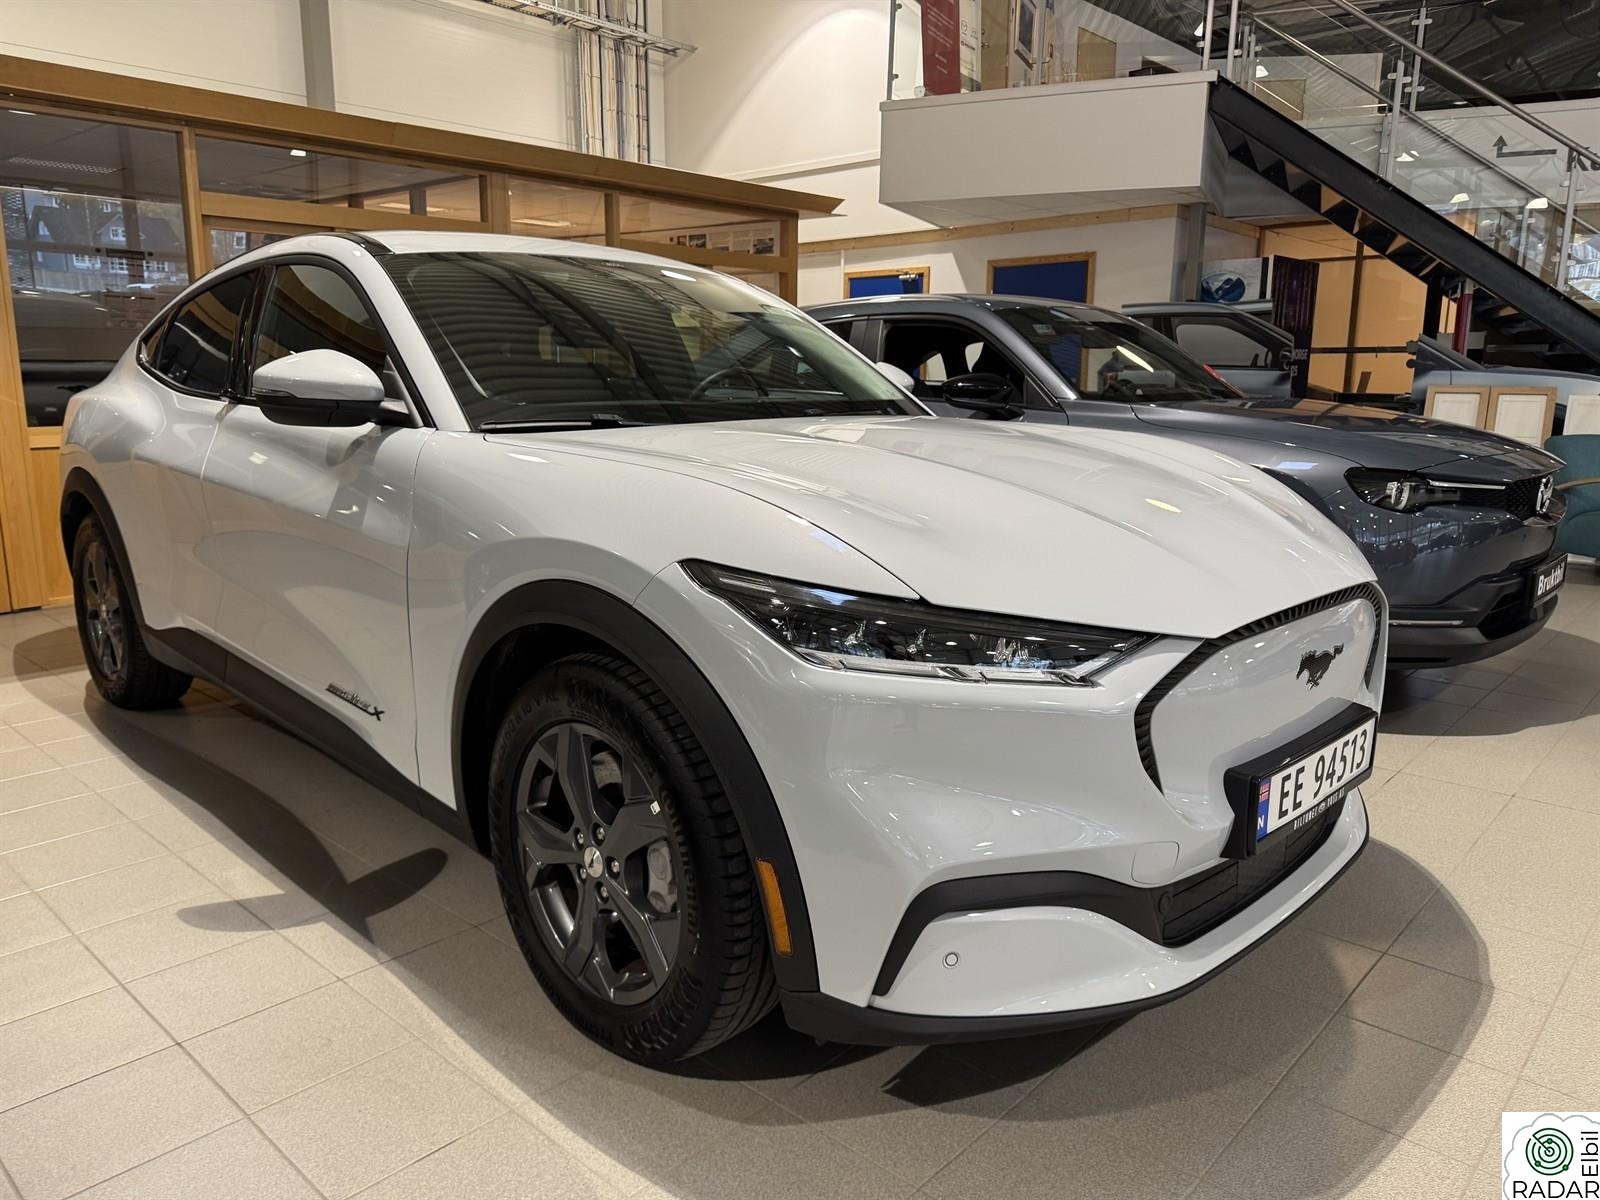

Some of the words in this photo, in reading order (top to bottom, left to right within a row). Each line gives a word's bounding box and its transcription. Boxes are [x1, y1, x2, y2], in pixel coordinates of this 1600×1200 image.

[1278, 766, 1305, 820] EE
[1313, 728, 1368, 799] 94513
[1257, 814, 1264, 829] N
